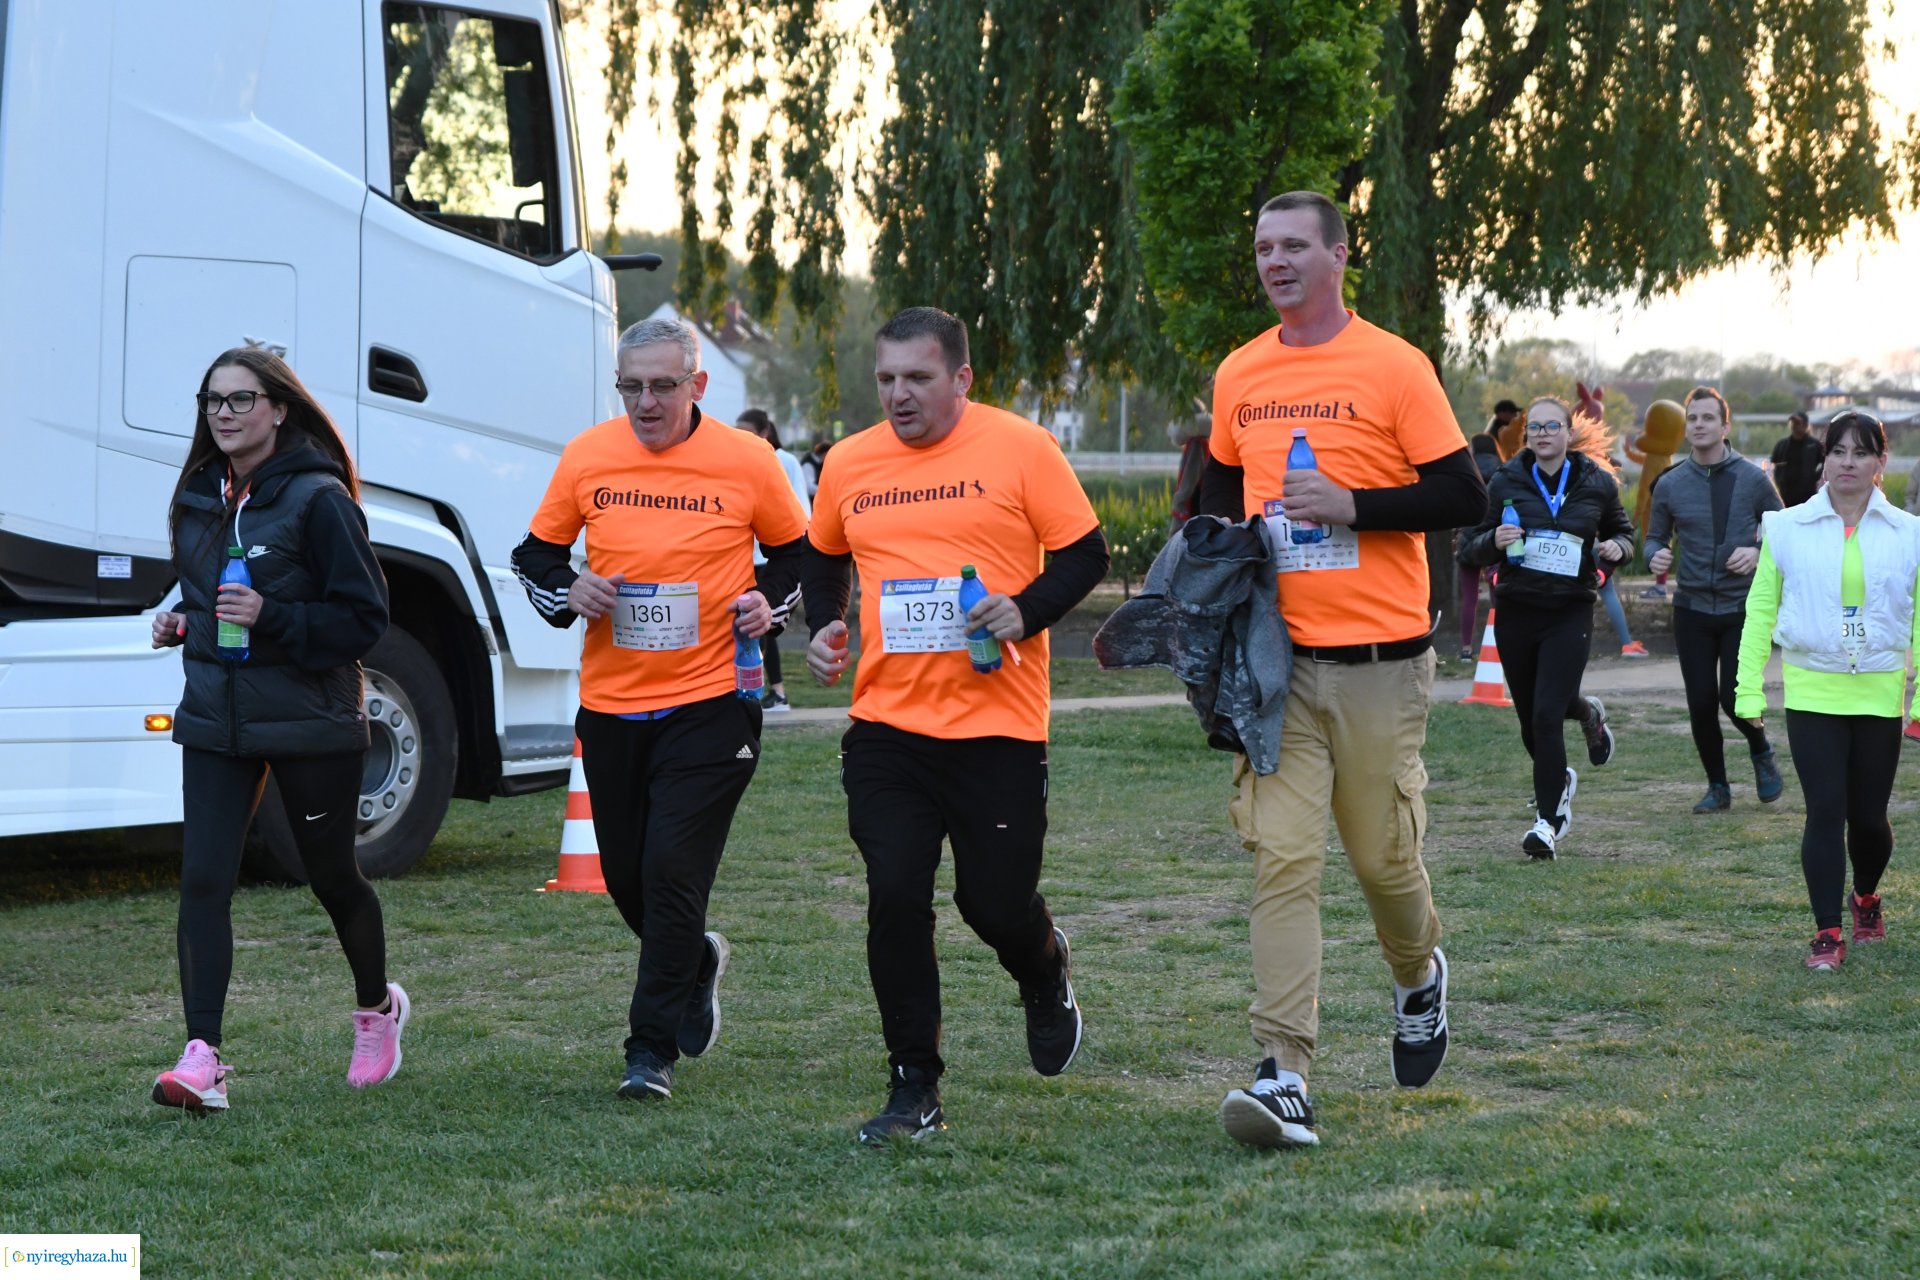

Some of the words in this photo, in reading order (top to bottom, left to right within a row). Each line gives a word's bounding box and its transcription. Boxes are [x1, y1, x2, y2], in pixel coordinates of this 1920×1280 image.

[1238, 400, 1339, 428] Continental
[593, 486, 706, 512] Continental
[853, 480, 965, 514] Continental
[1538, 541, 1568, 557] 1570
[630, 604, 671, 623] 1361
[904, 600, 954, 623] 1373
